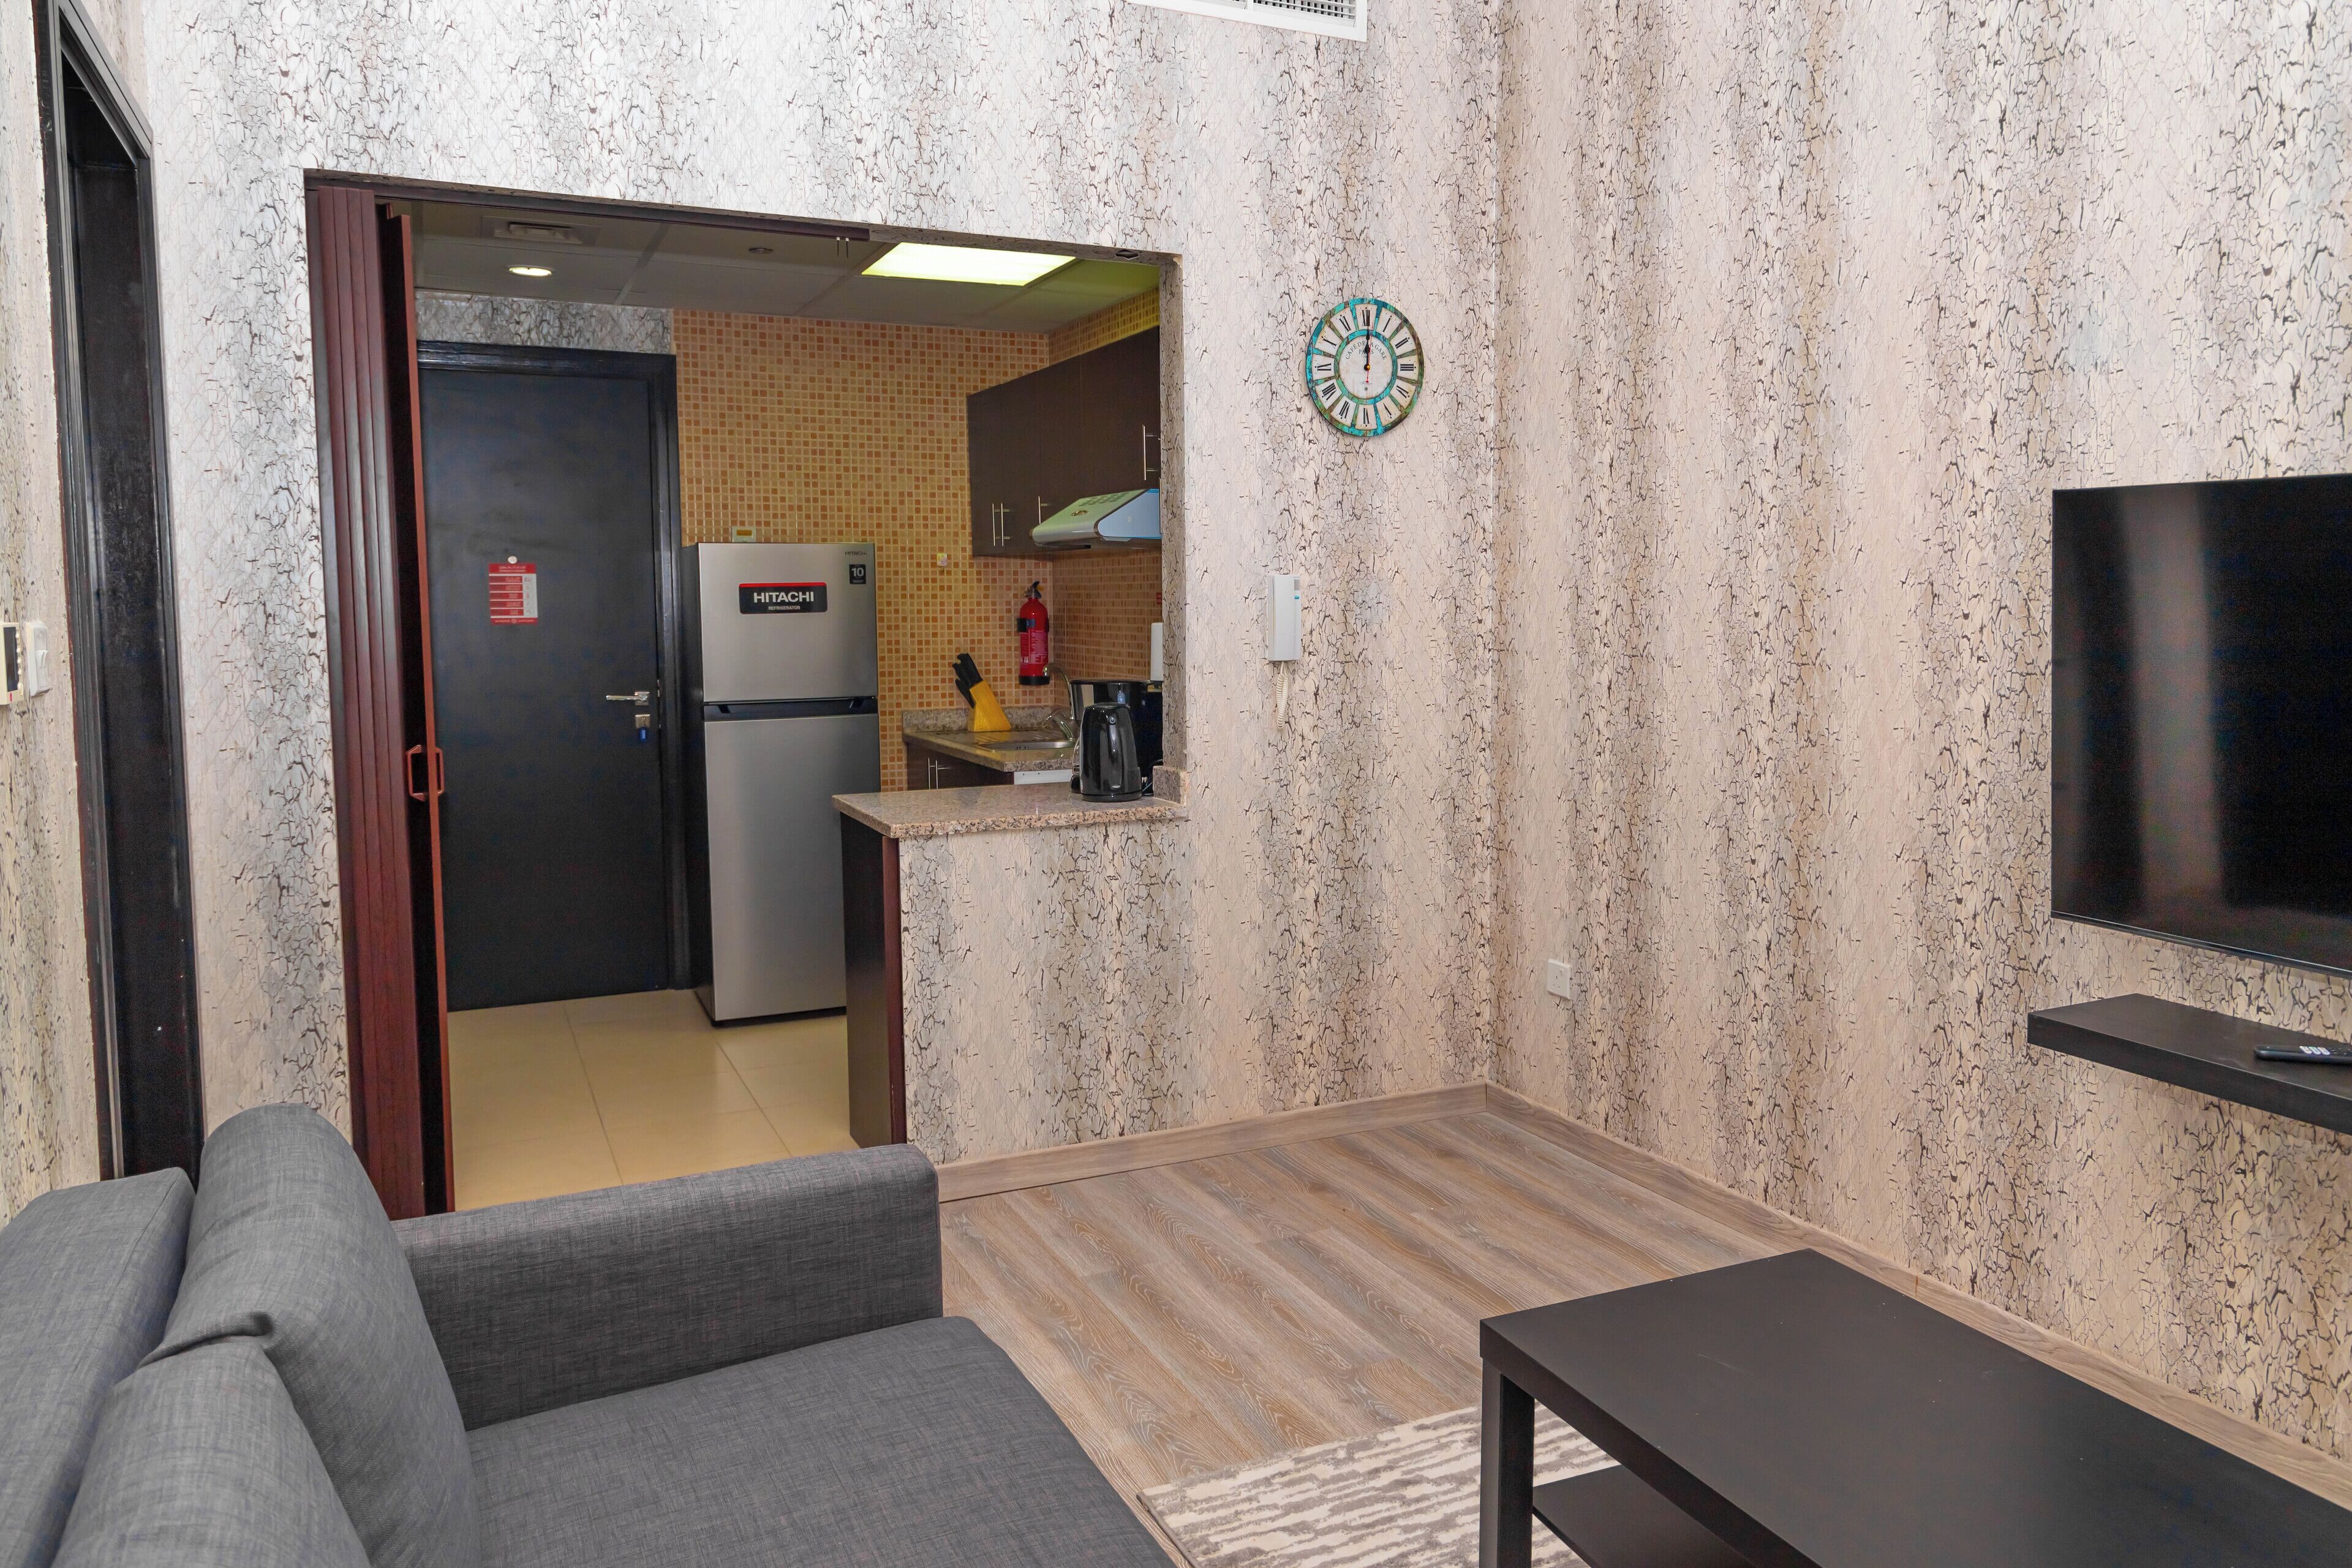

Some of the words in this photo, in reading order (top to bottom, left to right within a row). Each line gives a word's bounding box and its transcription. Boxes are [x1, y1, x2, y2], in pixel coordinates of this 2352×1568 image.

[1395, 337, 1409, 350] II
[1374, 344, 1387, 360] GARE
[851, 567, 864, 577] 10
[753, 591, 814, 603] HITACHI
